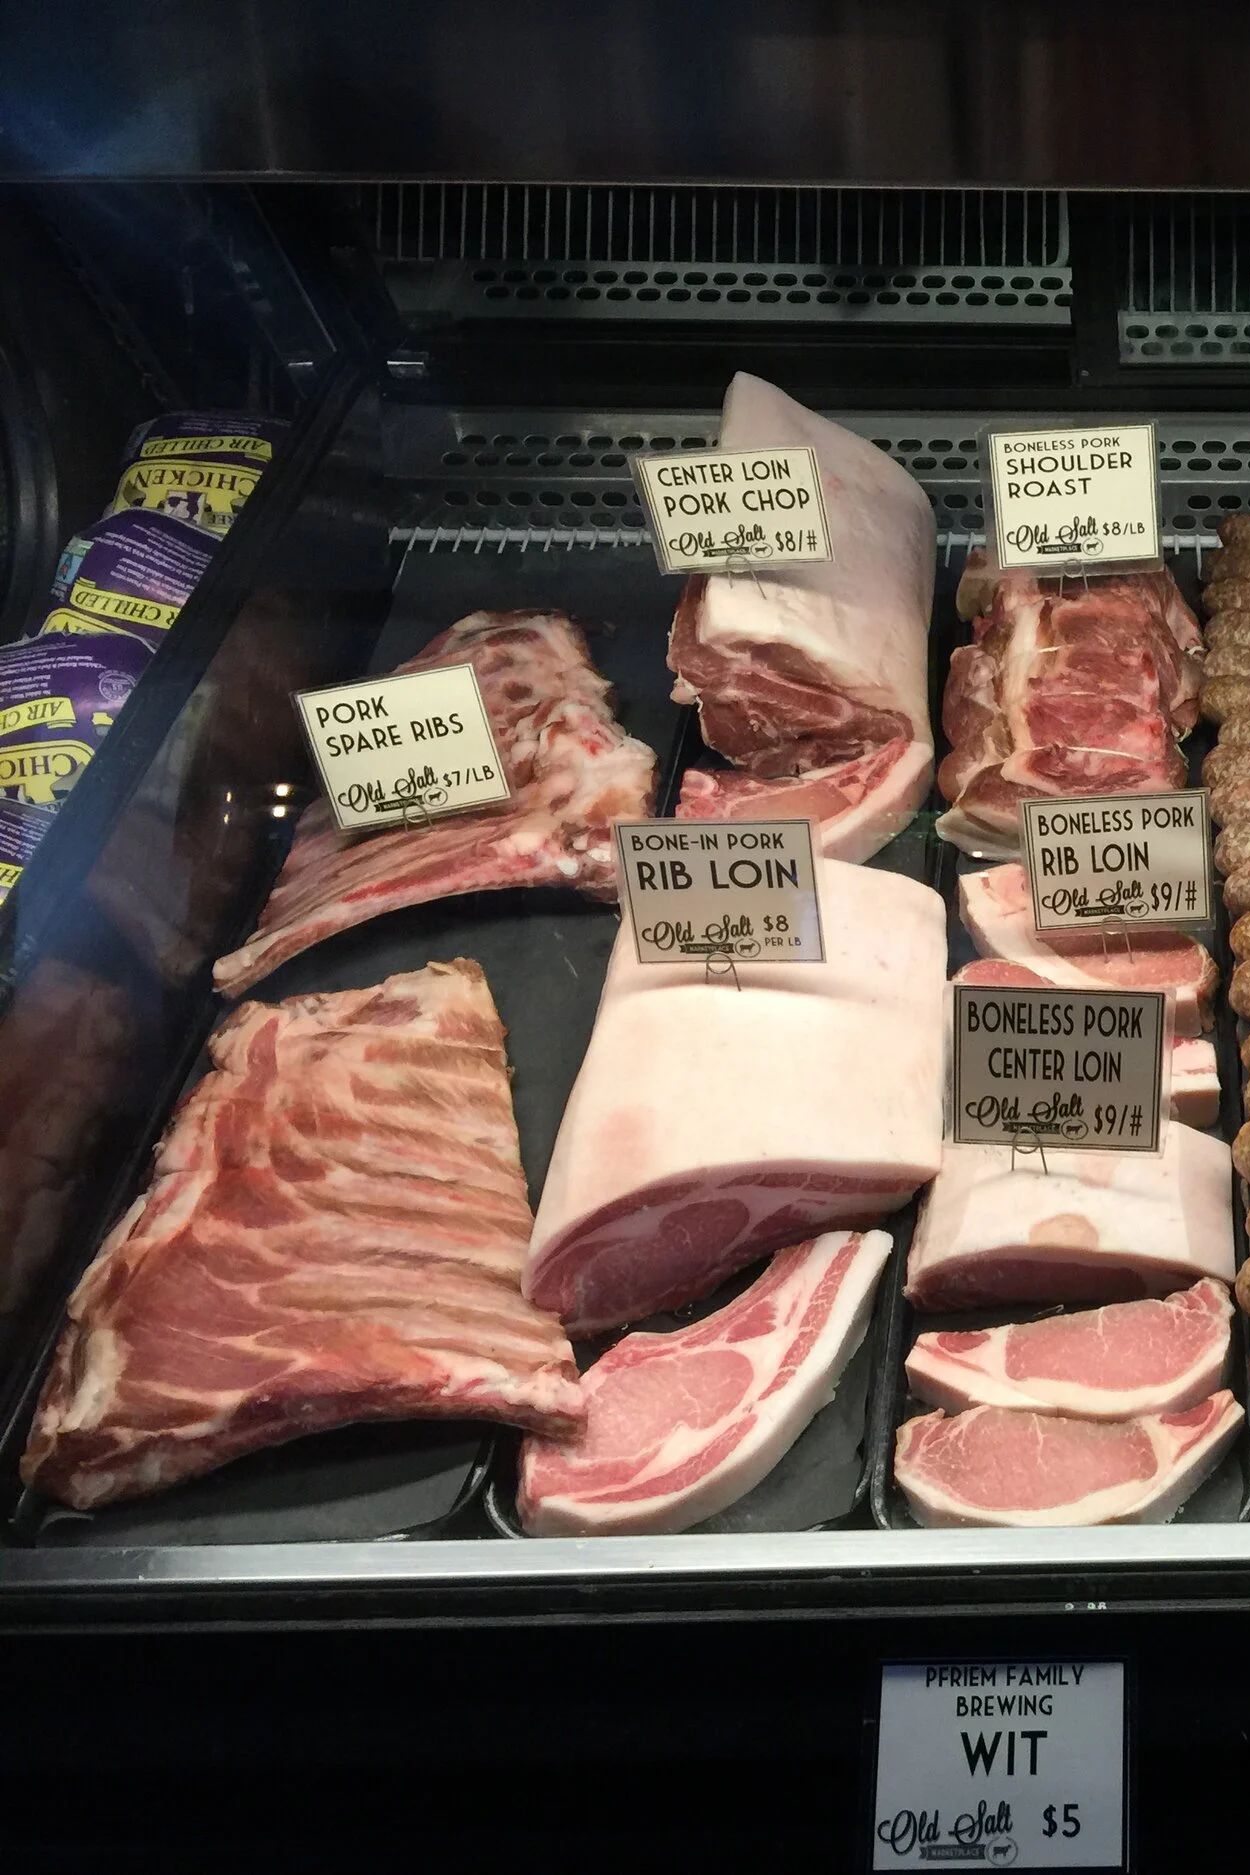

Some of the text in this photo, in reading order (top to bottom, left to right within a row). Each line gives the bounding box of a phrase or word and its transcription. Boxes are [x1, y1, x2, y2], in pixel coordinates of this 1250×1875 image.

[145, 439, 265, 454] AIR CHILLED
[1004, 436, 1120, 453] BONELESS PORK
[657, 459, 790, 486] CENTER LOIN
[1006, 452, 1133, 475] SHOULDER
[134, 469, 256, 497] CHICKEN
[1008, 478, 1091, 499] ROAST
[663, 488, 810, 517] PORK CHOP
[669, 531, 715, 556] Old
[721, 524, 766, 549] Salt
[1006, 516, 1145, 552] Old Salt $8/LB
[75, 591, 161, 620] CHILLED
[28, 700, 64, 720] AIR
[316, 696, 389, 729] PORK
[326, 713, 464, 757] SPARE RIBS
[338, 780, 386, 812] Old
[392, 766, 439, 798] Salt
[442, 765, 495, 787] $7/LB
[1038, 806, 1195, 836] BONELESS PORK
[631, 833, 785, 851] BONE-IN PORK
[1041, 841, 1150, 876] RIB LOIN
[636, 859, 799, 891] RIB LOIN
[1042, 887, 1089, 916] Old
[1095, 879, 1144, 906] Salt
[641, 914, 789, 950] Old Salt $8
[765, 937, 801, 947] PER LB
[968, 1001, 1143, 1038] BONELESS PORK
[988, 1047, 1122, 1083] CENTER LOIN
[965, 1095, 1020, 1128] Old
[1027, 1091, 1084, 1124] Salt
[926, 1664, 1085, 1687] PFRIEM FAMILY
[956, 1694, 1053, 1717] BREWING
[960, 1730, 1048, 1777] WIT
[877, 1799, 1081, 1855] Old Salt $5
